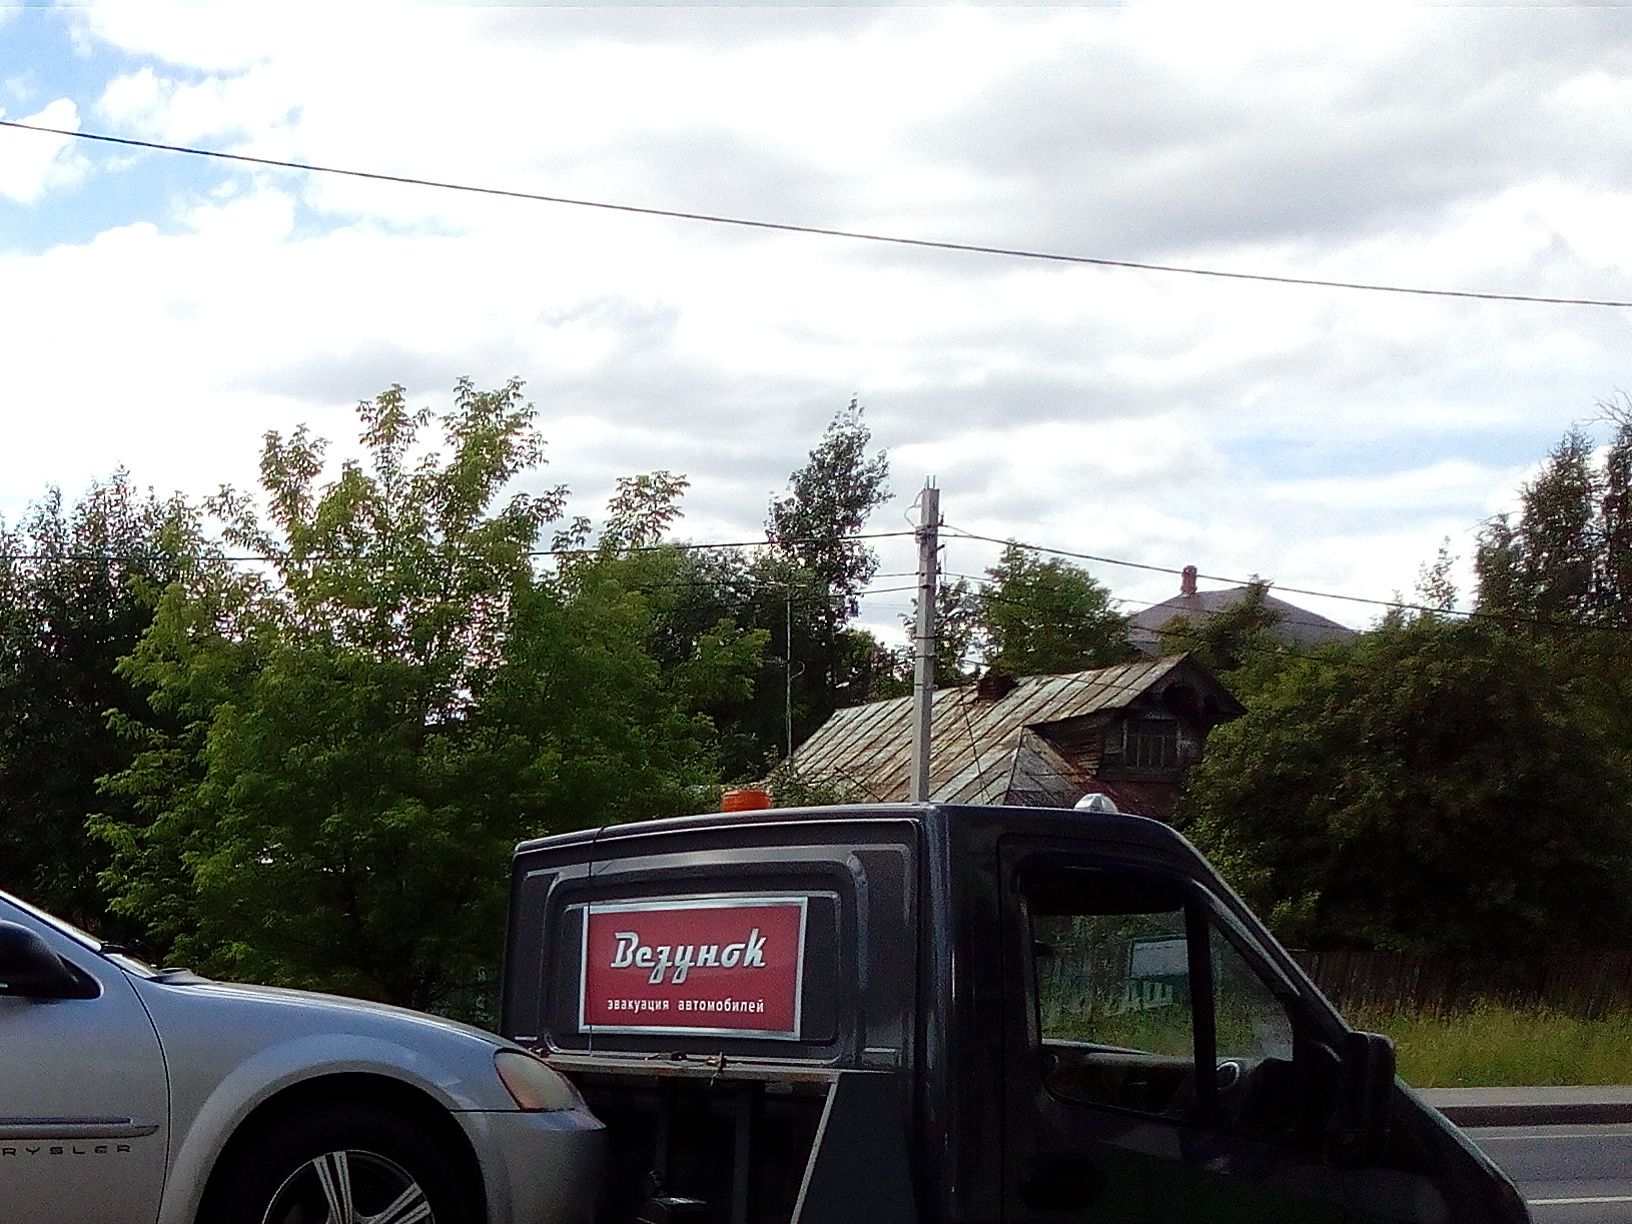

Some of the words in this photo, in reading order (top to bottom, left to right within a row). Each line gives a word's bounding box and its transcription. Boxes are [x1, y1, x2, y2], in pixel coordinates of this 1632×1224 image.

[610, 928, 767, 984] Везунок
[607, 999, 670, 1014] эвакуация
[677, 997, 764, 1013] автомобилей
